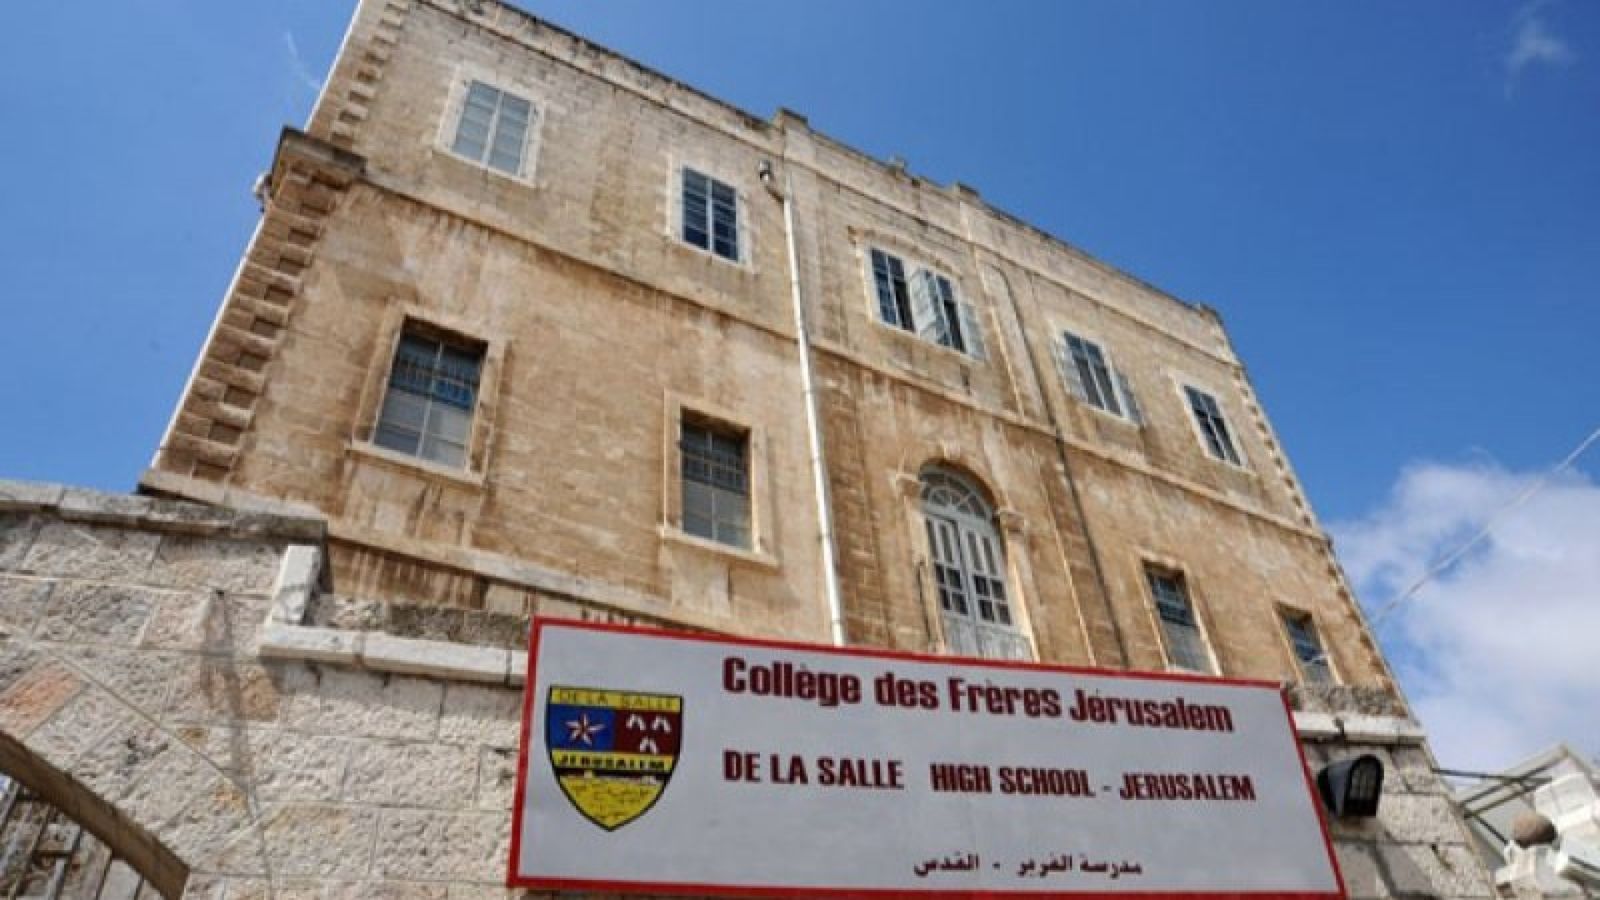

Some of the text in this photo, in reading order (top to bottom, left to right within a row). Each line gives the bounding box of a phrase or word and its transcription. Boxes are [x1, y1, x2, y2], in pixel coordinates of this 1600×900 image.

[722, 656, 1234, 733] Collège des Frères Jérusalem
[559, 754, 665, 769] JERUSALEM
[723, 750, 761, 782] DE
[769, 754, 809, 785] LA
[816, 757, 904, 790] SALLE
[930, 763, 992, 794] HIGH
[998, 766, 1096, 798] SCHOOL
[1119, 773, 1256, 800] JERUSALEM
[913, 851, 980, 878] القدس
[1079, 853, 1143, 880] مدرسة
